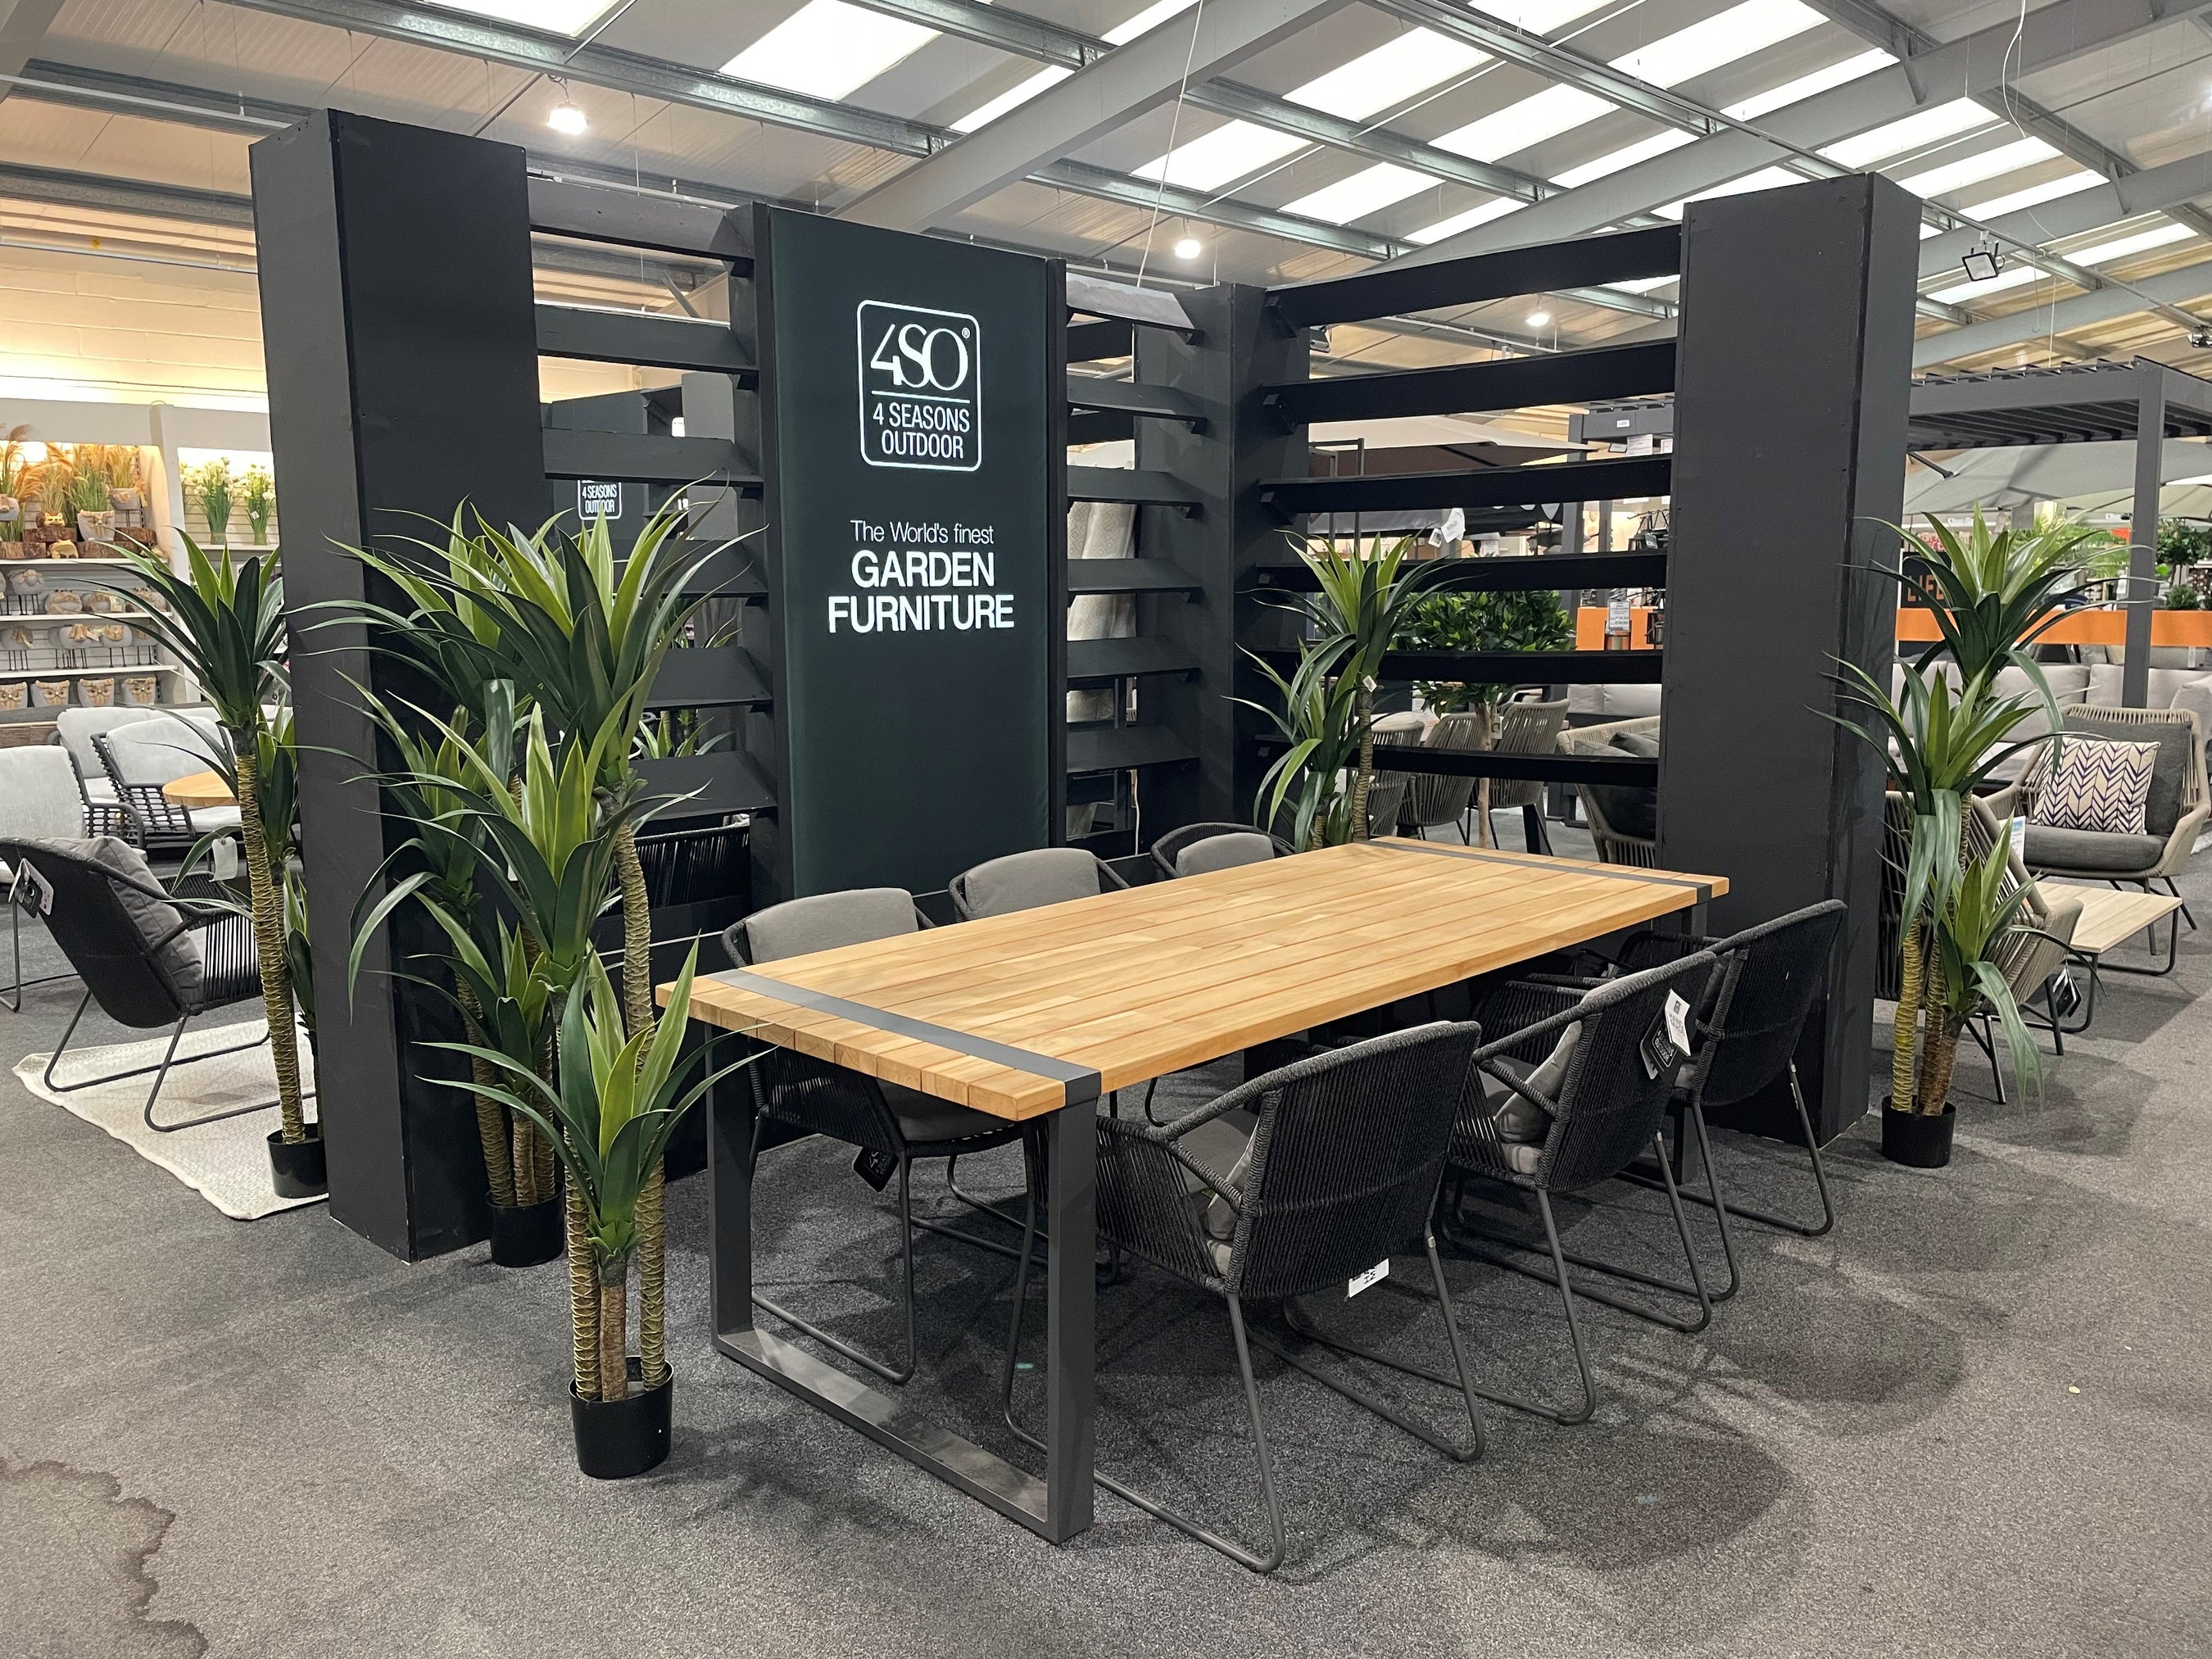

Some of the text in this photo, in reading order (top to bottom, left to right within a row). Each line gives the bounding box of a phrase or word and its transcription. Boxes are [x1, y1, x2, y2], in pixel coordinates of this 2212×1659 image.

[873, 402, 971, 433] 4 SEASONS
[881, 430, 964, 460] OUTDOOR
[582, 483, 617, 499] 4 SEASONS
[850, 519, 995, 545] The World's finest
[851, 549, 995, 588] GARDEN
[827, 594, 1015, 634] FURNITURE
